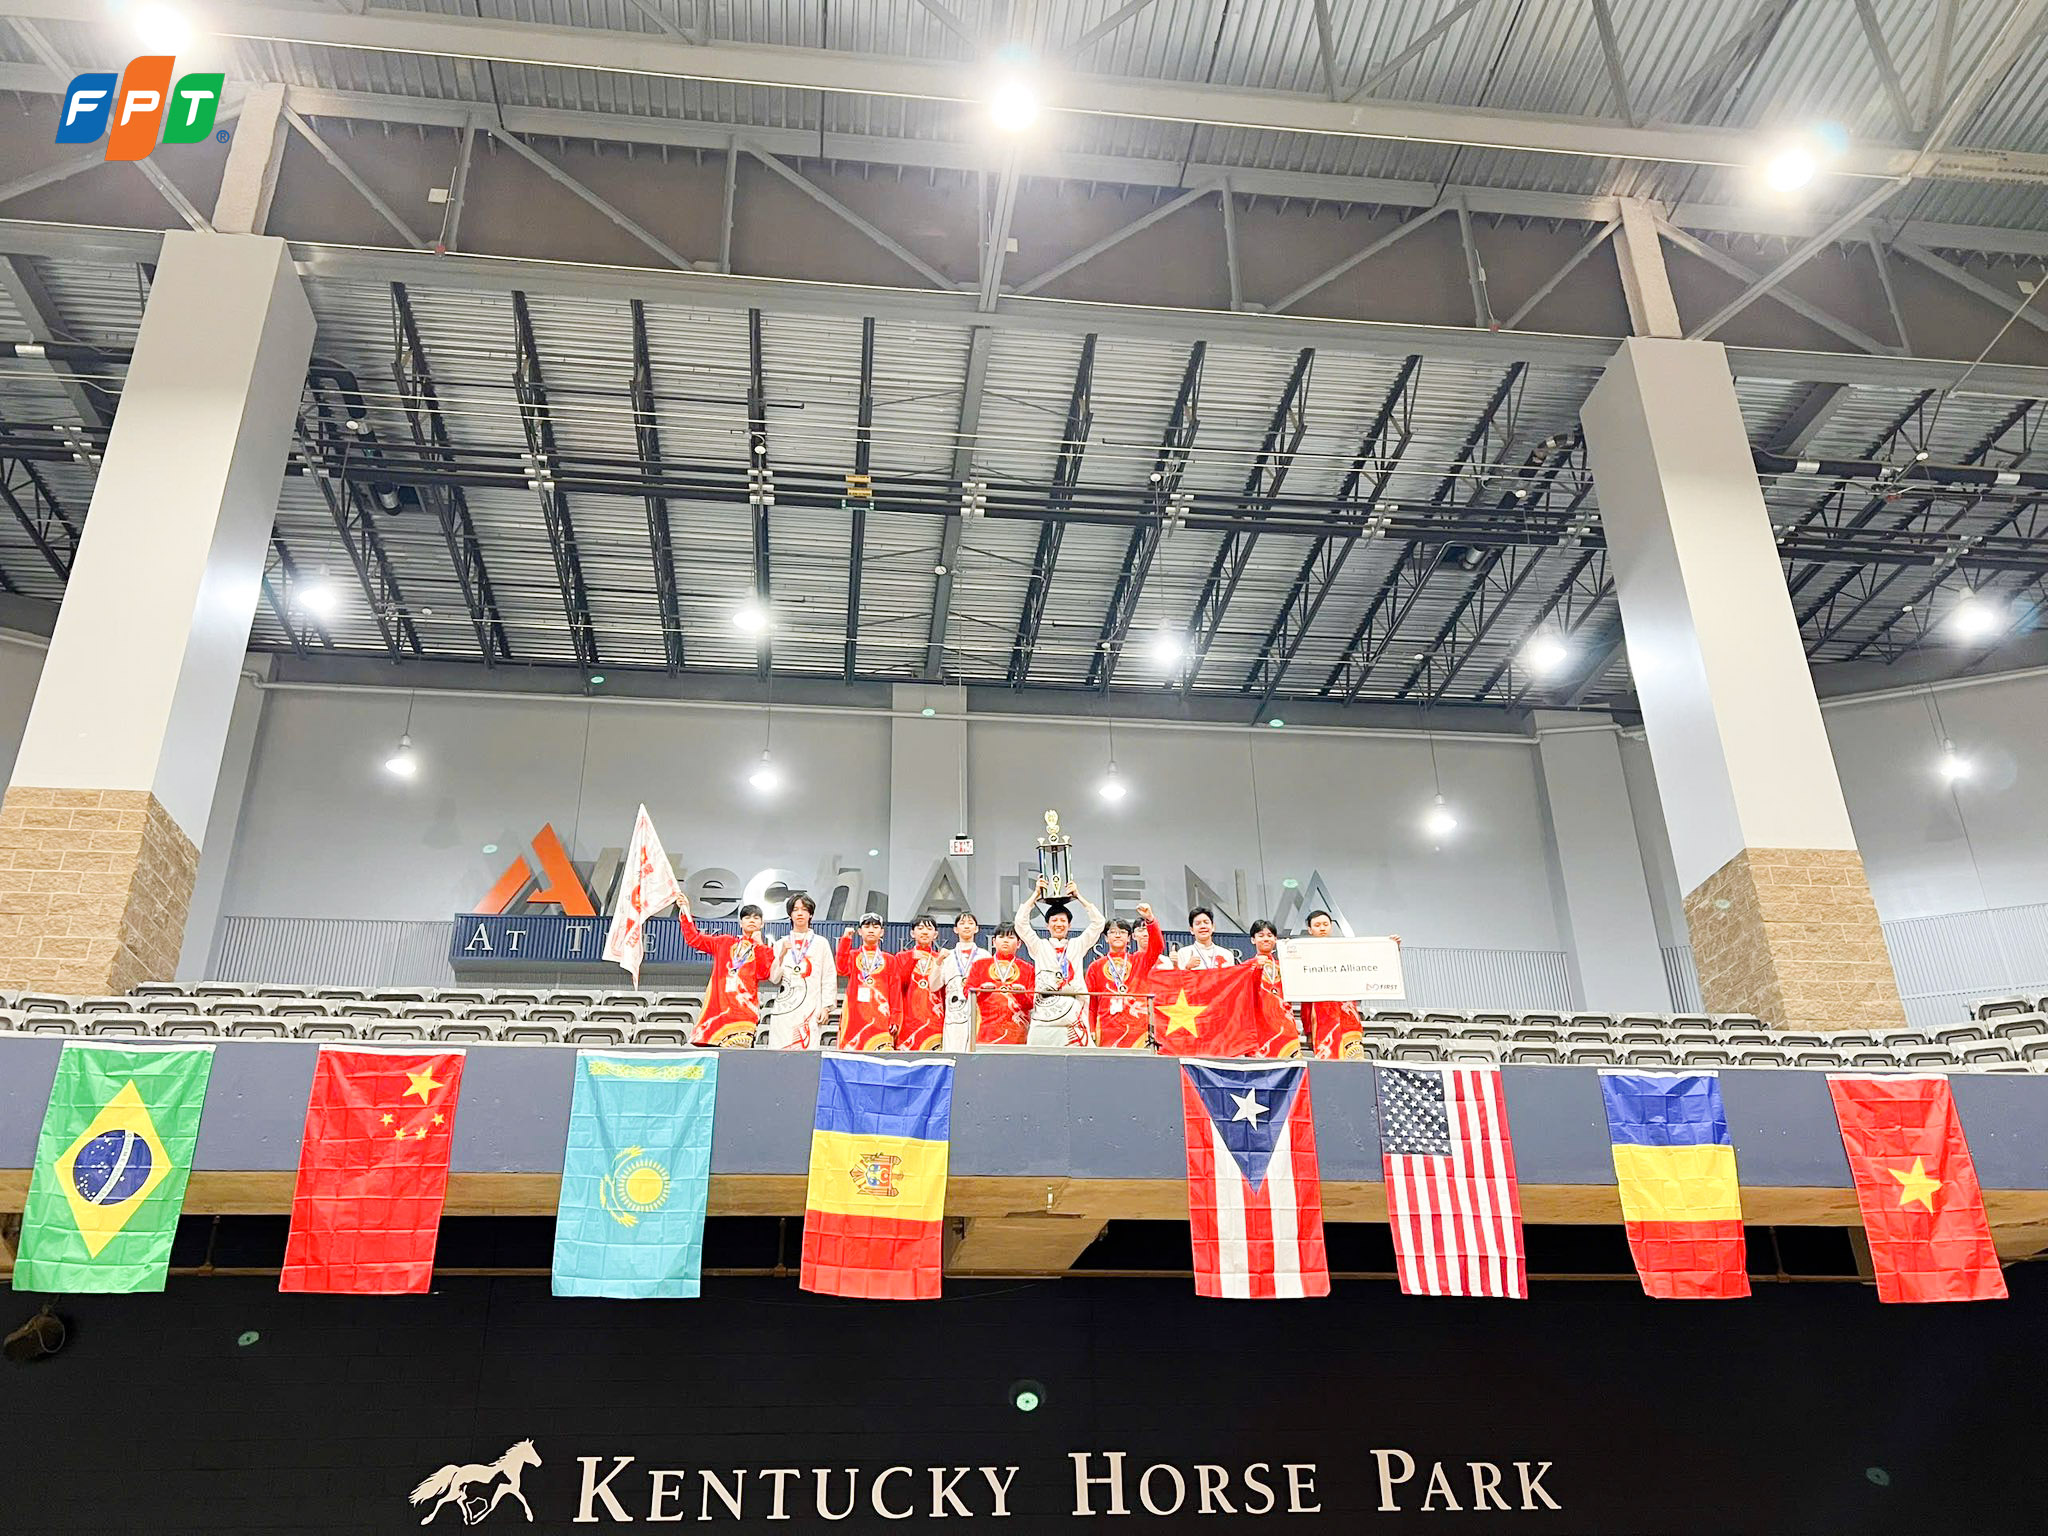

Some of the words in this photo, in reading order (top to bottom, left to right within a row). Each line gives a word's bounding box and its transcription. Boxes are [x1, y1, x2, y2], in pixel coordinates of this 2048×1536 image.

[953, 841, 970, 852] EXIT
[1303, 964, 1338, 973] Finalist
[1340, 964, 1378, 973] Alliance
[573, 1457, 1019, 1522] KENTUCKY
[1068, 1452, 1321, 1515] HORSE
[1370, 1450, 1561, 1511] PARK
